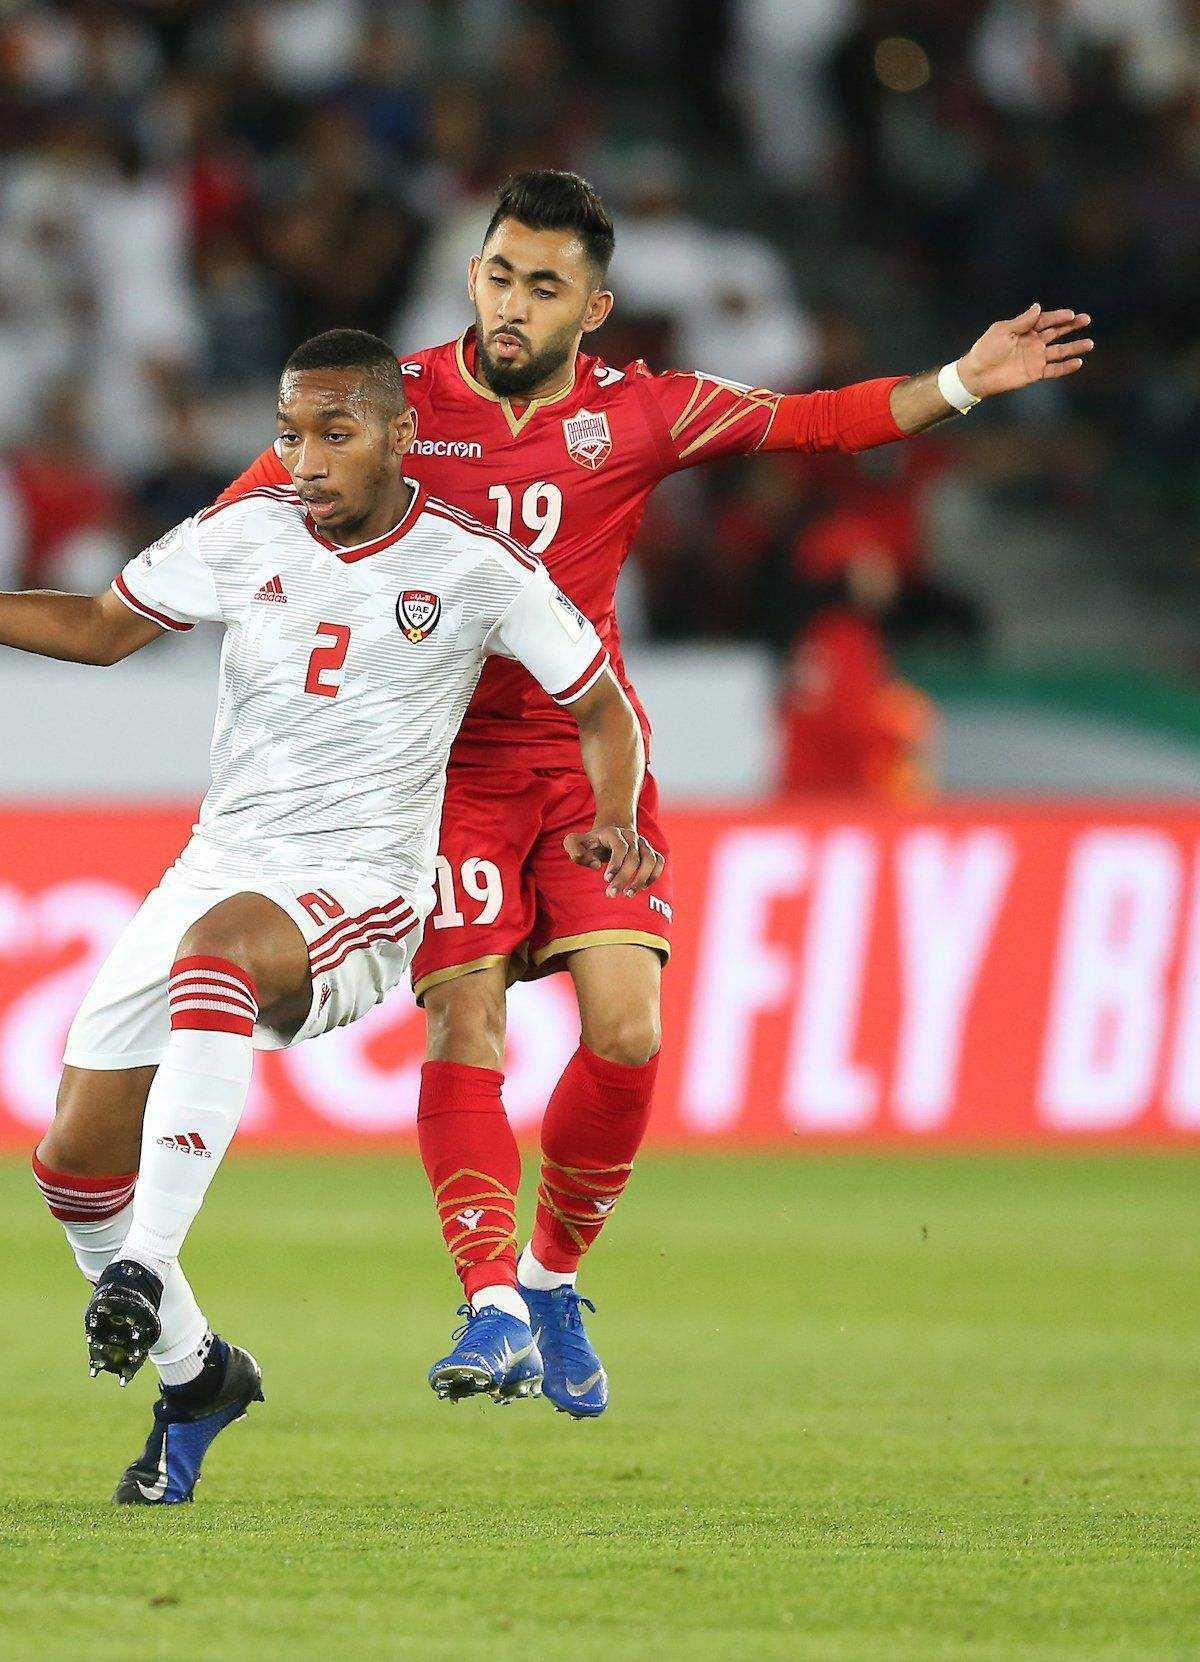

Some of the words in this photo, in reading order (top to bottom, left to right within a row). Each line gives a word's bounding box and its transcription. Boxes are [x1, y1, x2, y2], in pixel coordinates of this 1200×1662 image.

[488, 481, 563, 554] 19
[254, 592, 288, 604] adidas
[408, 603, 430, 614] UAE
[412, 612, 424, 620] FA
[305, 621, 351, 699] 2
[297, 887, 345, 926] 2
[433, 855, 503, 929] 19
[679, 825, 1017, 1131] FLY
